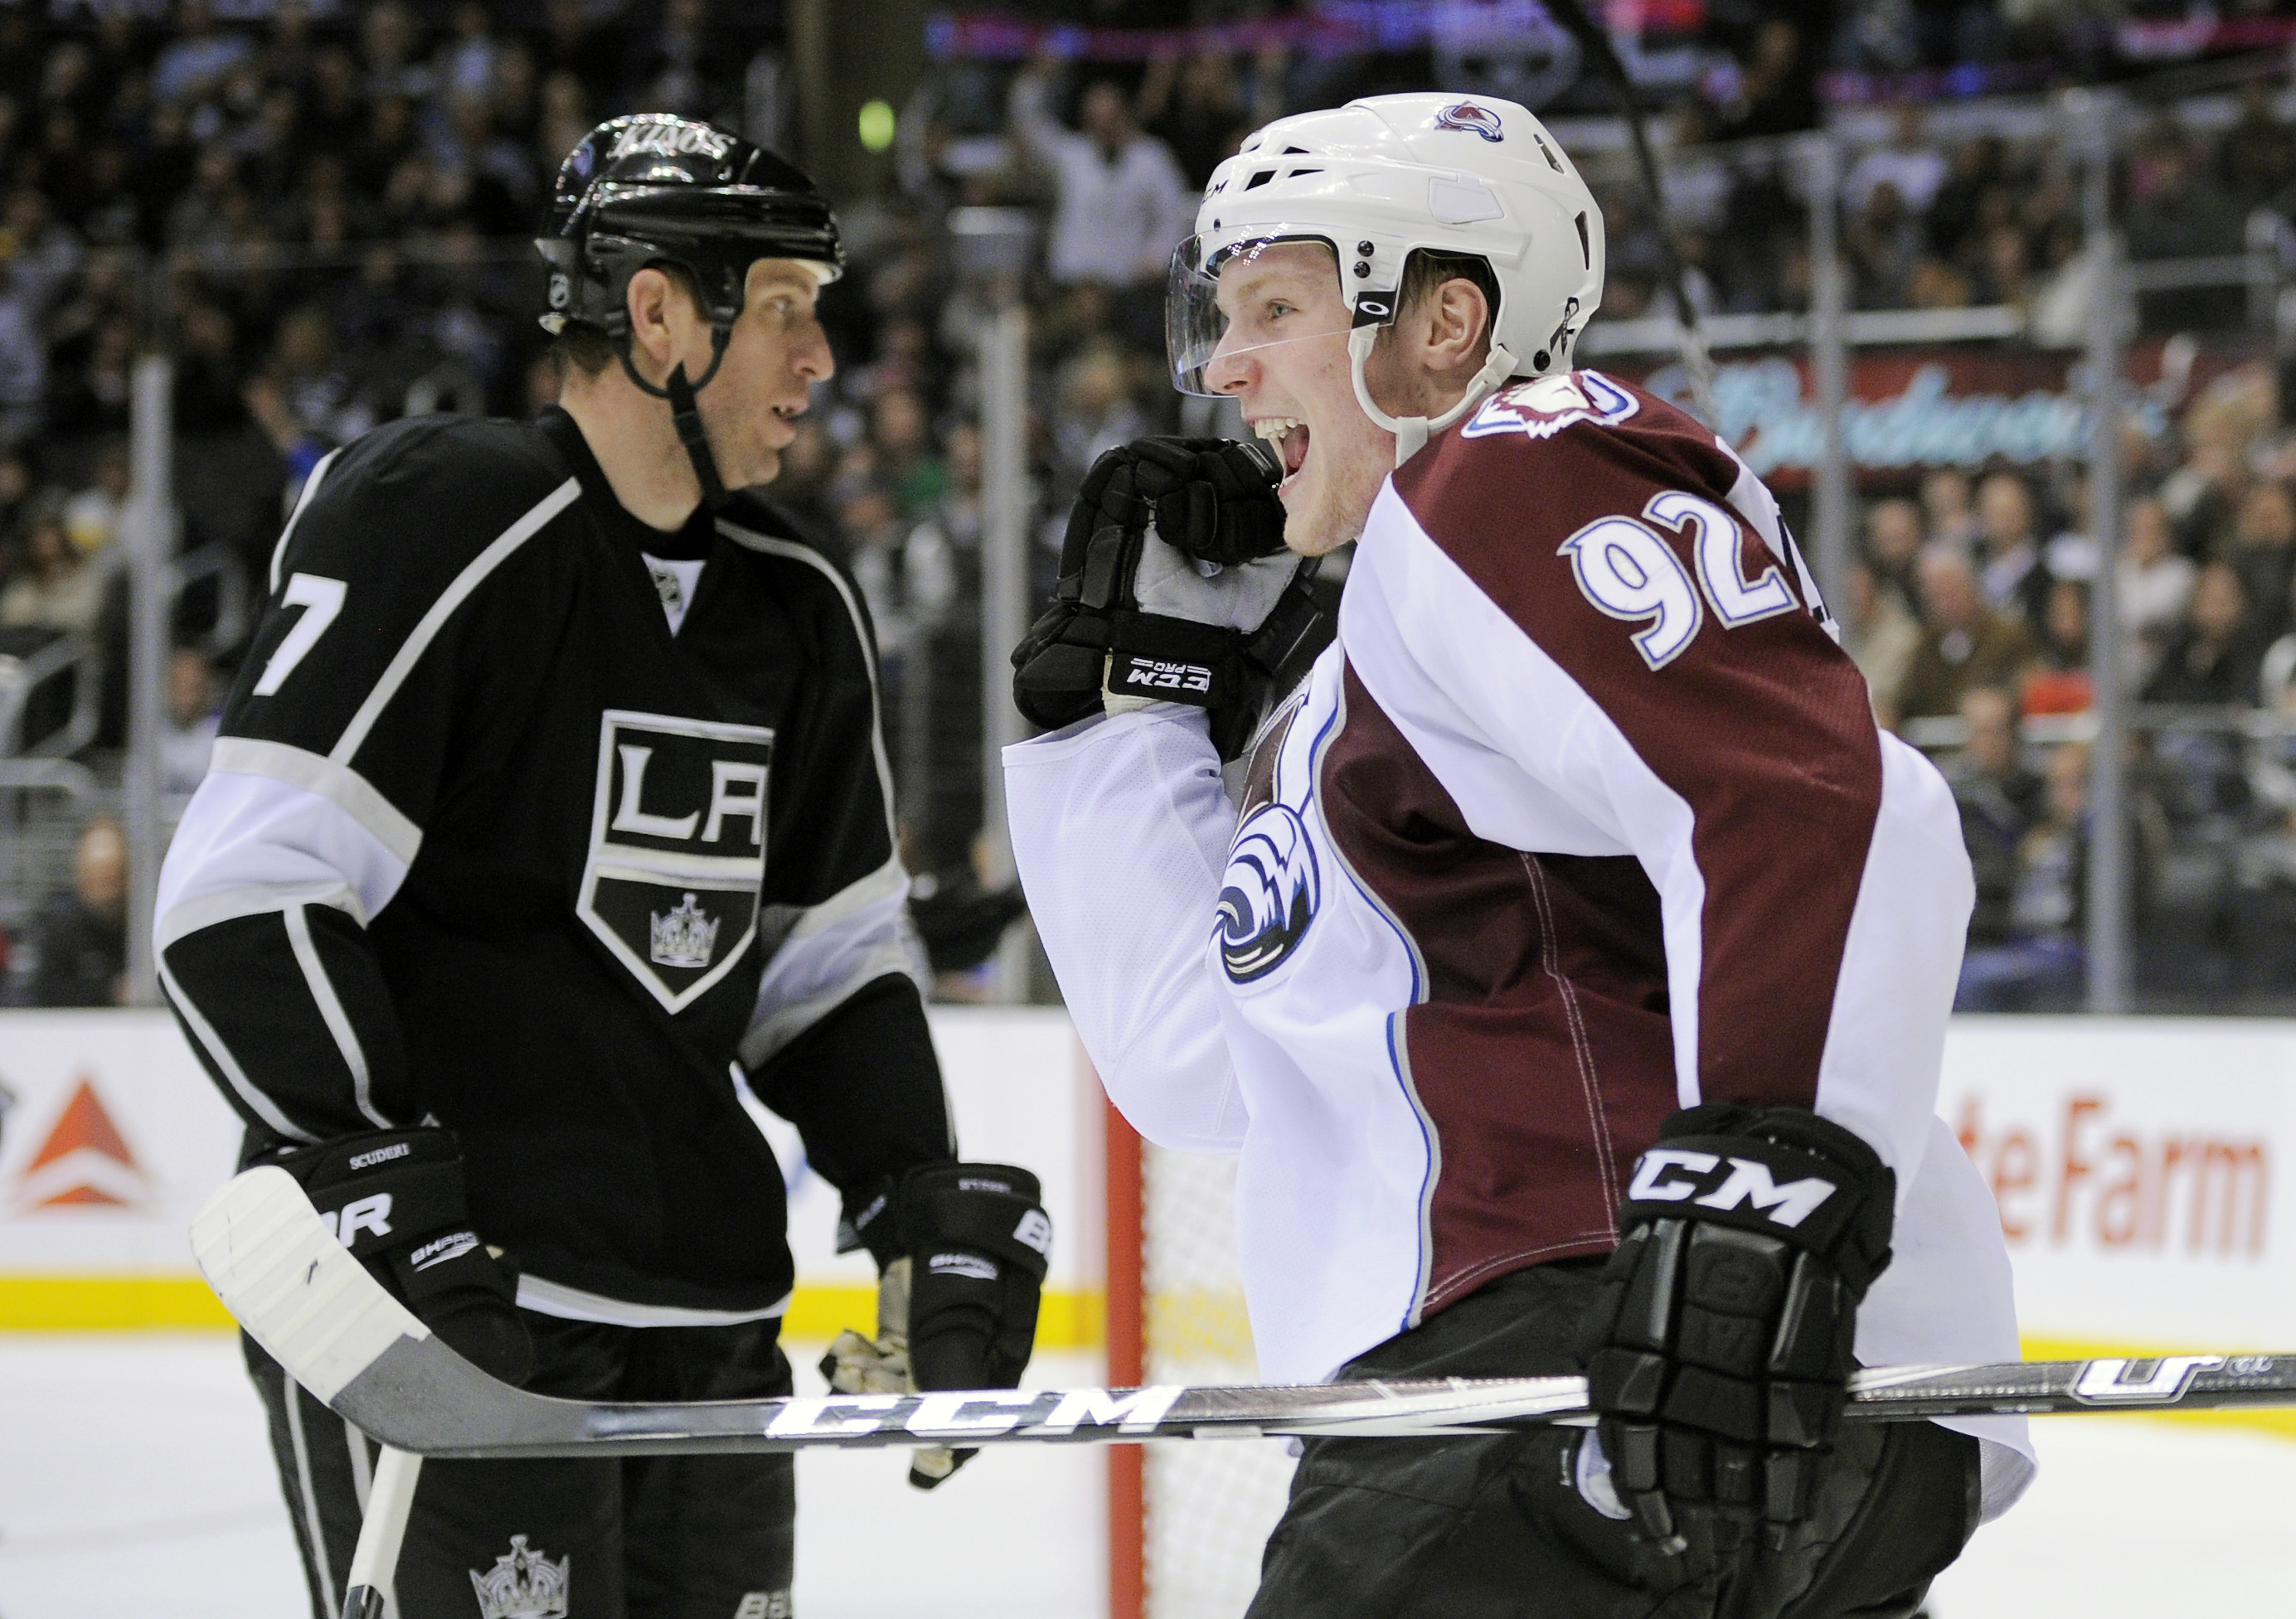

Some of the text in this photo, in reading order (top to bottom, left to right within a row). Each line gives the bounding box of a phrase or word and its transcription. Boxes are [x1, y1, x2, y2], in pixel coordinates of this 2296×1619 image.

[1556, 490, 1801, 672] 92
[252, 572, 348, 696] 7
[1127, 668, 1211, 692] CCM
[1153, 662, 1187, 674] PRO
[612, 744, 769, 845] LA
[349, 1142, 411, 1171] SCUDERI
[1629, 1149, 1837, 1229] CM
[765, 1386, 1187, 1439] CCM
